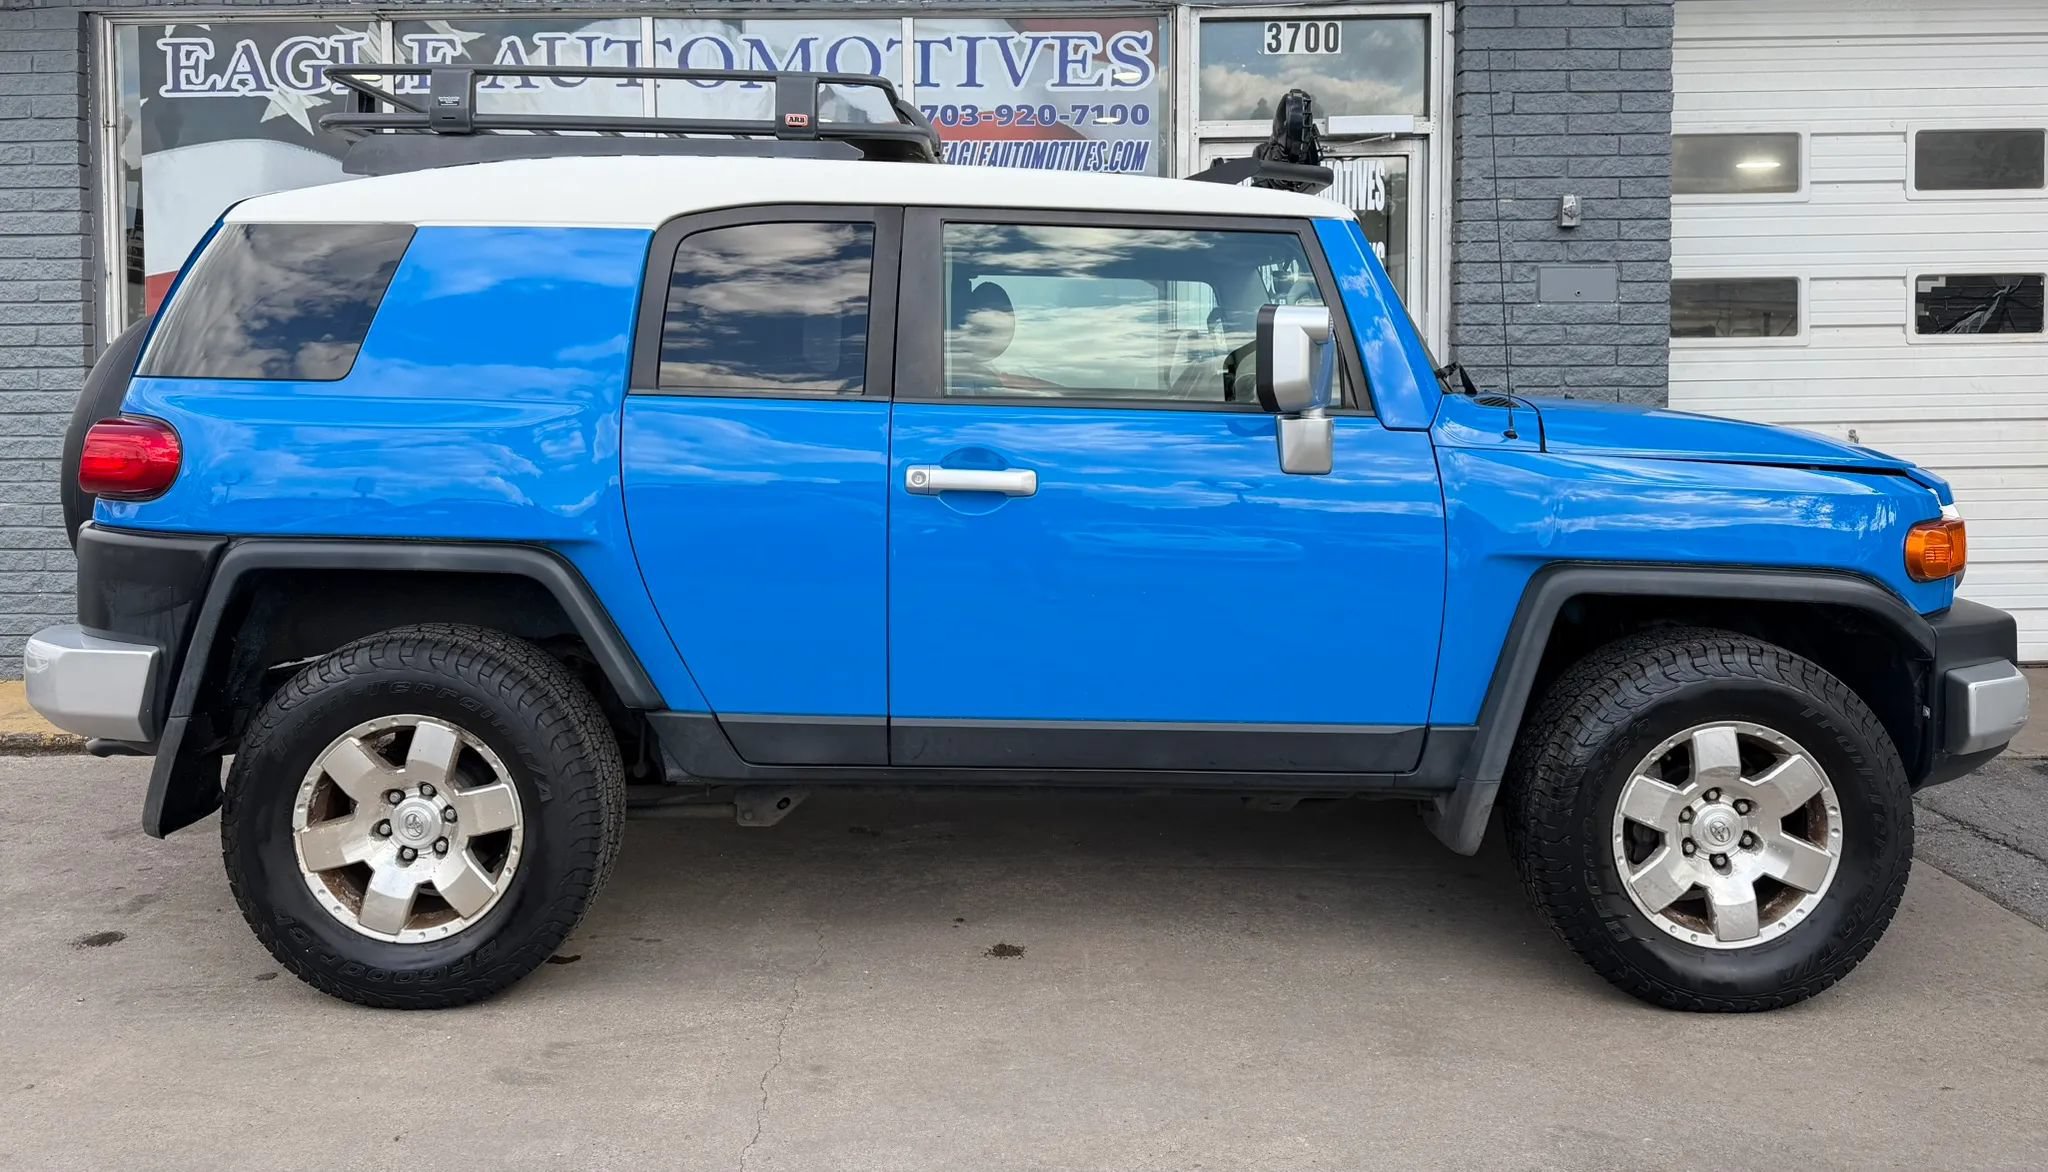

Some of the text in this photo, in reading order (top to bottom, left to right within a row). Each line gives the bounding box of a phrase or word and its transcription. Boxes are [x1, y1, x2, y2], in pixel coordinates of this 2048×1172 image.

[1266, 22, 1339, 53] 3700
[159, 33, 1153, 96] EAGLE AUTOMOTIVES
[920, 103, 1150, 126] 703-920-7100
